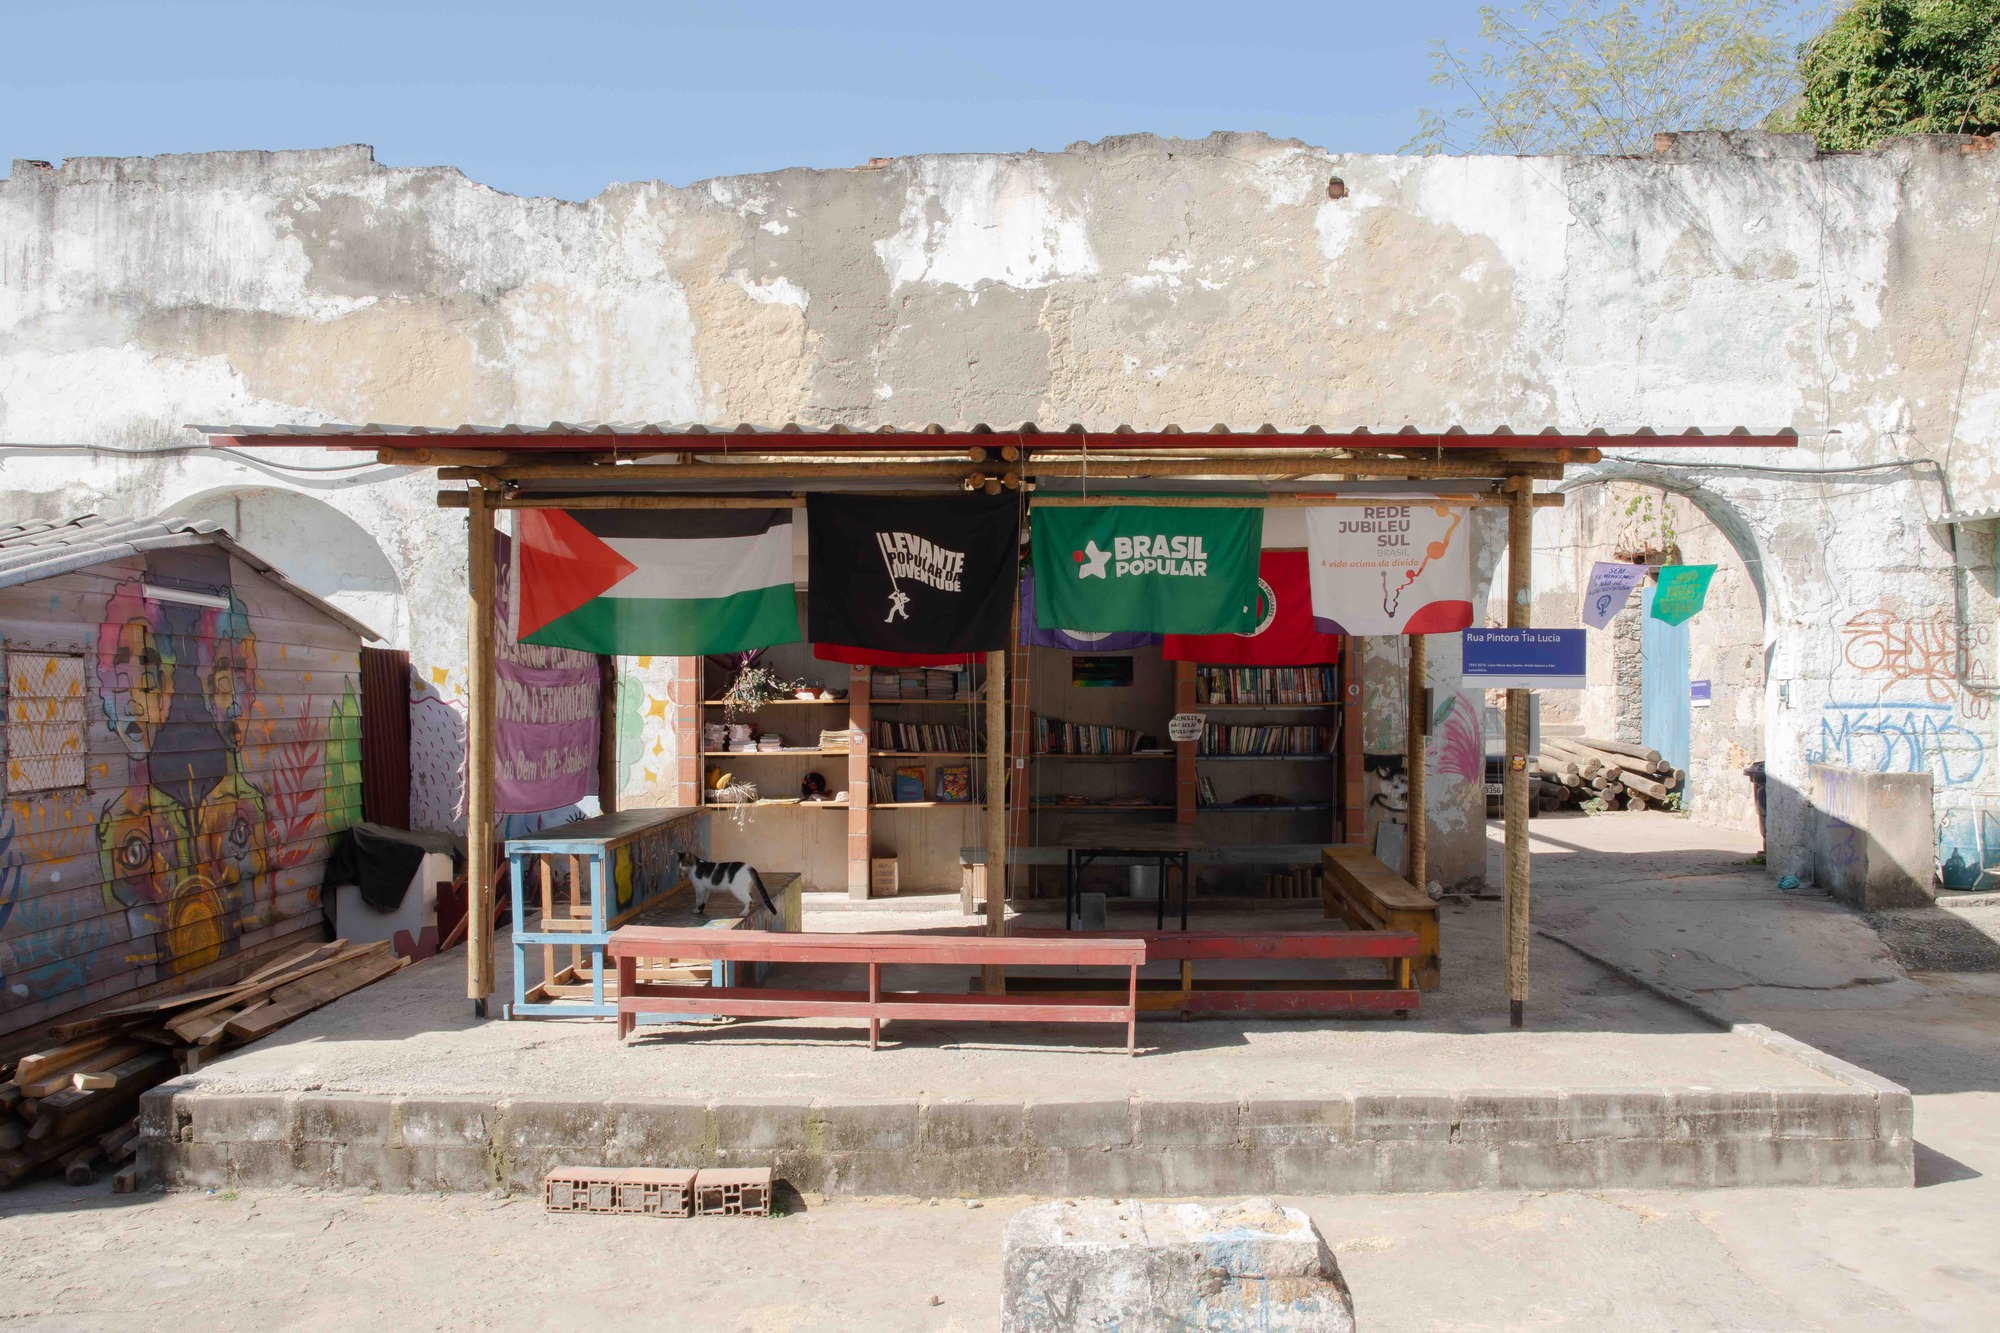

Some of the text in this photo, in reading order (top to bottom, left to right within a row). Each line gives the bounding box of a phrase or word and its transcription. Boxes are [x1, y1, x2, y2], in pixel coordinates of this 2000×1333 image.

[1364, 506, 1410, 519] REDE
[1338, 520, 1410, 533] JUBILEU
[1377, 534, 1410, 547] SUL
[881, 532, 965, 573] LEVANTE
[1114, 535, 1207, 560] BRASIL
[1377, 549, 1410, 557] BRASIL
[888, 552, 943, 579] POPULAR
[1115, 559, 1207, 577] POPULAR
[1329, 560, 1347, 568] vida
[1349, 560, 1376, 568] acima
[892, 564, 961, 592] JUVENTUDE
[1467, 633, 1484, 642] Rua
[1486, 633, 1519, 642] Pintora
[1522, 633, 1535, 642] Tia
